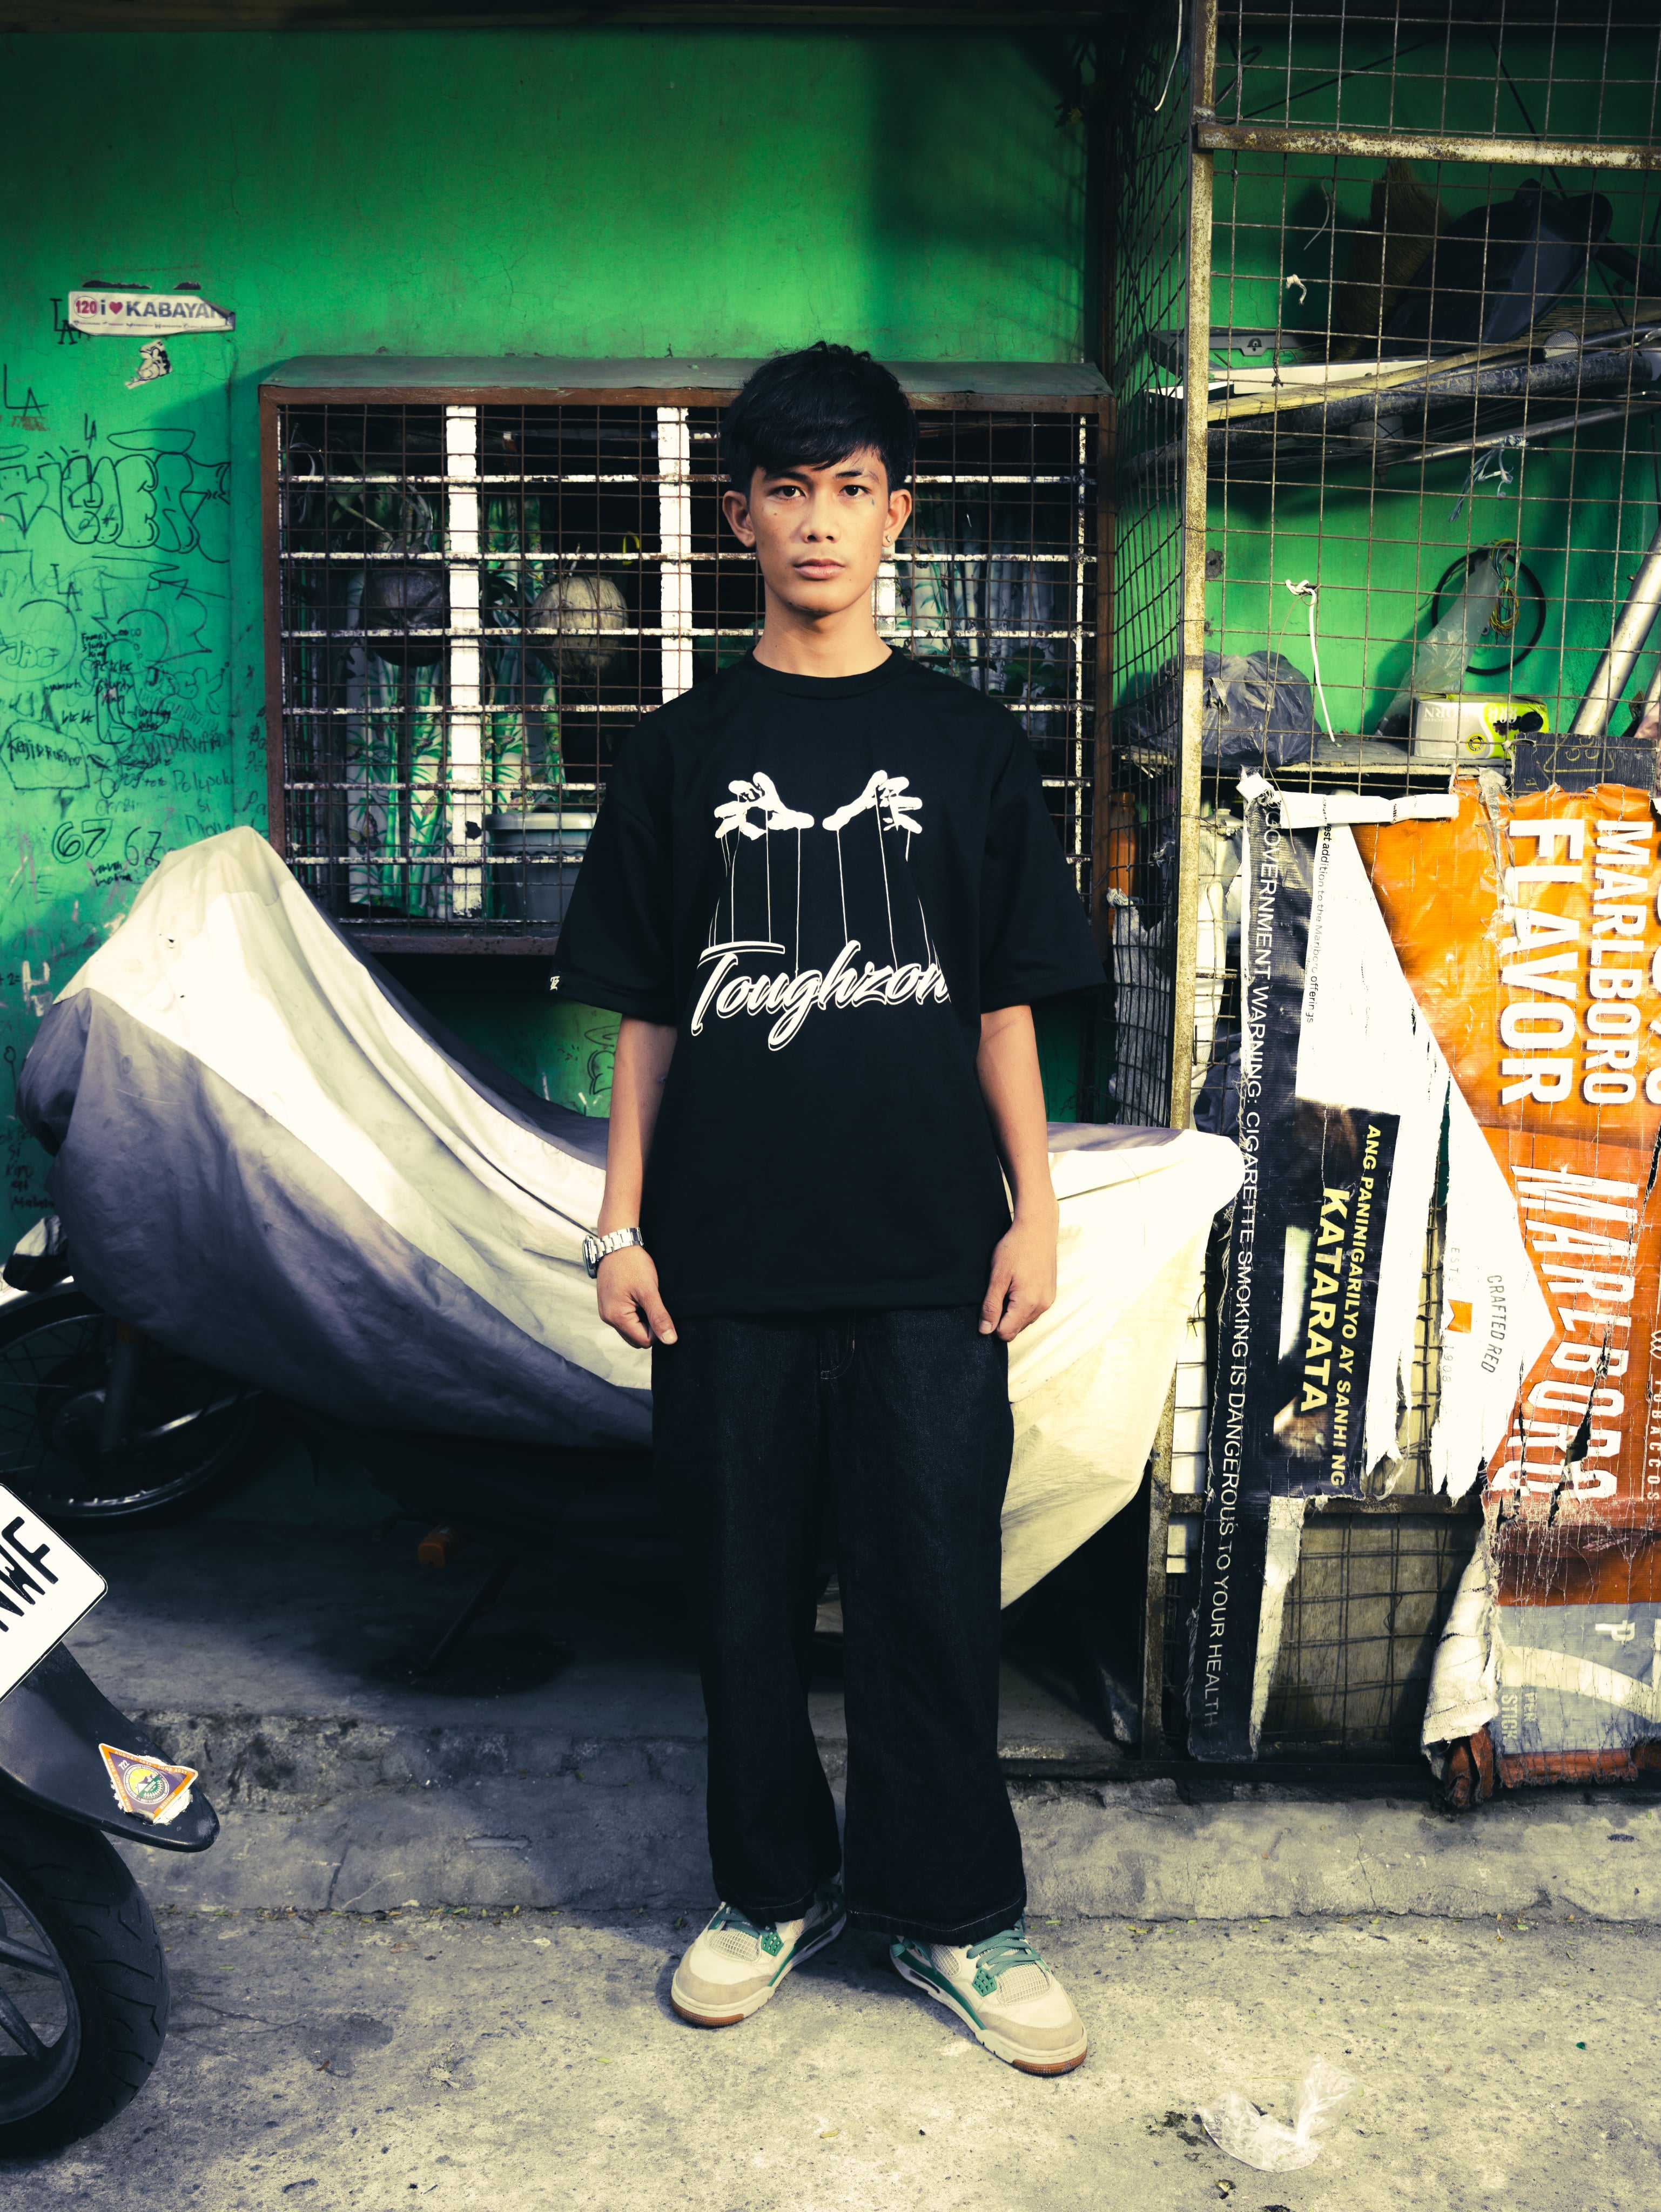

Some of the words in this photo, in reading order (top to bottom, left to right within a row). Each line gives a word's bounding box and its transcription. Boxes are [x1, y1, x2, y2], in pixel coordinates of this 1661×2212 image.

[76, 300, 98, 314] 120
[52, 818, 113, 864] 67
[1323, 823, 1332, 841] est
[1318, 843, 1330, 887] addition
[1255, 812, 1281, 980] GOVERNMENT
[1317, 891, 1324, 901] to
[1501, 819, 1586, 1106] FLAVOR
[1583, 820, 1653, 1105] MARLBORO
[1306, 976, 1318, 1023] offerings
[1247, 986, 1269, 1103] WARNING:
[1363, 1124, 1381, 1170] ANG
[1240, 1112, 1260, 1243] CIGARETTE
[1342, 1176, 1374, 1339] PANINIGARILYO
[1232, 1251, 1252, 1358] SMOKING
[1301, 1187, 1350, 1412] KATARATA
[1487, 1275, 1507, 1340] CRAFTED
[1491, 1165, 1638, 1499] MARLBORO
[1230, 1366, 1247, 1385] IS
[1339, 1344, 1354, 1374] AY
[1442, 1345, 1454, 1382] 1908
[1481, 1343, 1503, 1373] RED
[1333, 1380, 1351, 1447] SANHI
[1219, 1393, 1245, 1536] DANGEROUS
[1330, 1454, 1346, 1486] NG
[1216, 1541, 1232, 1570] TO
[1210, 1575, 1229, 1637] YOUR
[1205, 1644, 1223, 1727] HEALTH
[1501, 1694, 1518, 1740] STICK
[108, 1758, 116, 1772] PASS
[115, 1773, 126, 1797] VEHICLE
[160, 1792, 176, 1809] RESIDENT
